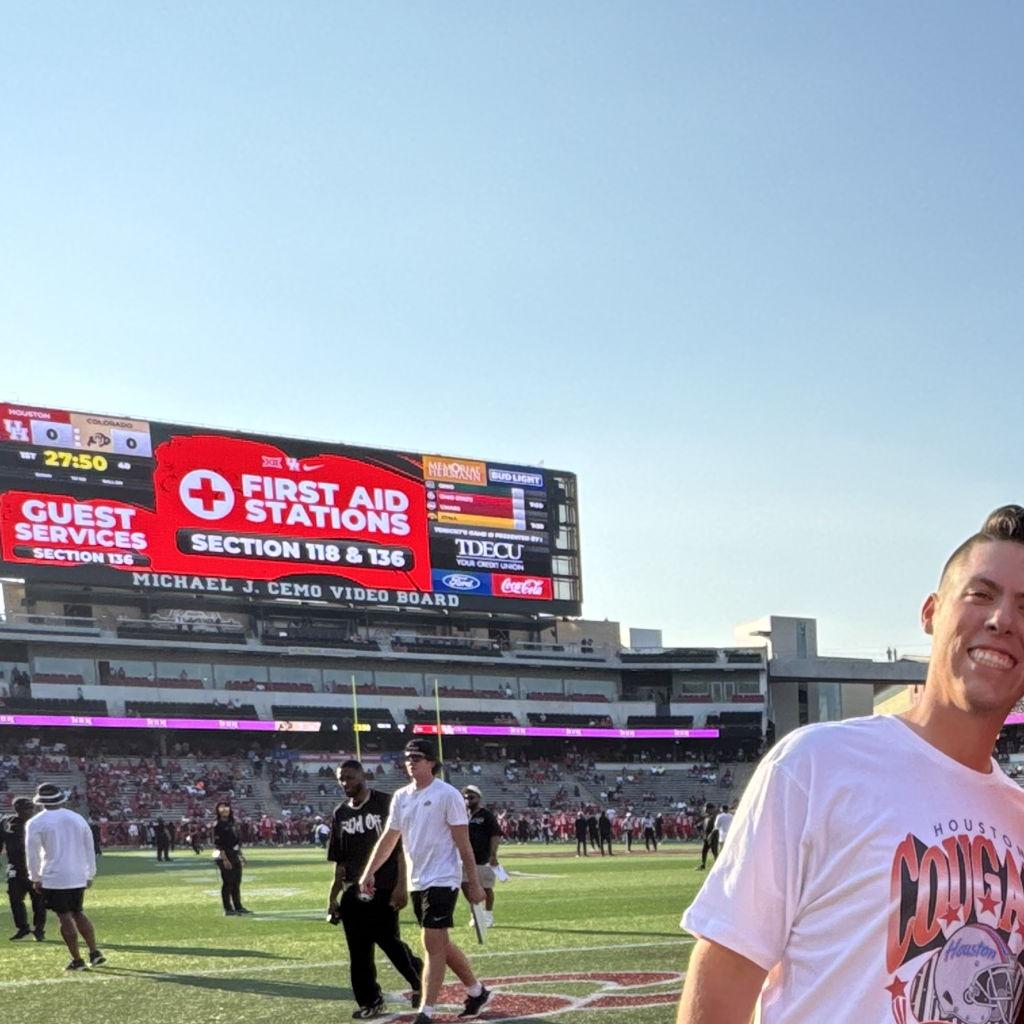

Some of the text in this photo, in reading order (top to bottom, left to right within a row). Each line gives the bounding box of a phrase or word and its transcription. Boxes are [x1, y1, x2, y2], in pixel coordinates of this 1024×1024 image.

[9, 408, 50, 419] HOUSTON
[86, 418, 133, 429] COLORADO
[46, 428, 58, 440] 0
[126, 438, 138, 450] 0
[43, 450, 108, 472] 27:50
[492, 472, 540, 484] BUD LIGHT
[241, 474, 410, 513] FIRST AID
[21, 499, 136, 530] GUEST
[244, 501, 411, 536] STATIONS
[14, 522, 148, 550] SERVICES
[32, 548, 134, 565] SECTION 136
[190, 534, 406, 568] SECTION 118 & 136
[455, 538, 525, 560] TDECU
[456, 558, 524, 571] YOUR CREDIT UNION
[132, 572, 460, 608] MICHAEL J. CEMO VIDEO BOARD
[446, 575, 474, 588] Ford
[944, 938, 997, 962] Houston
